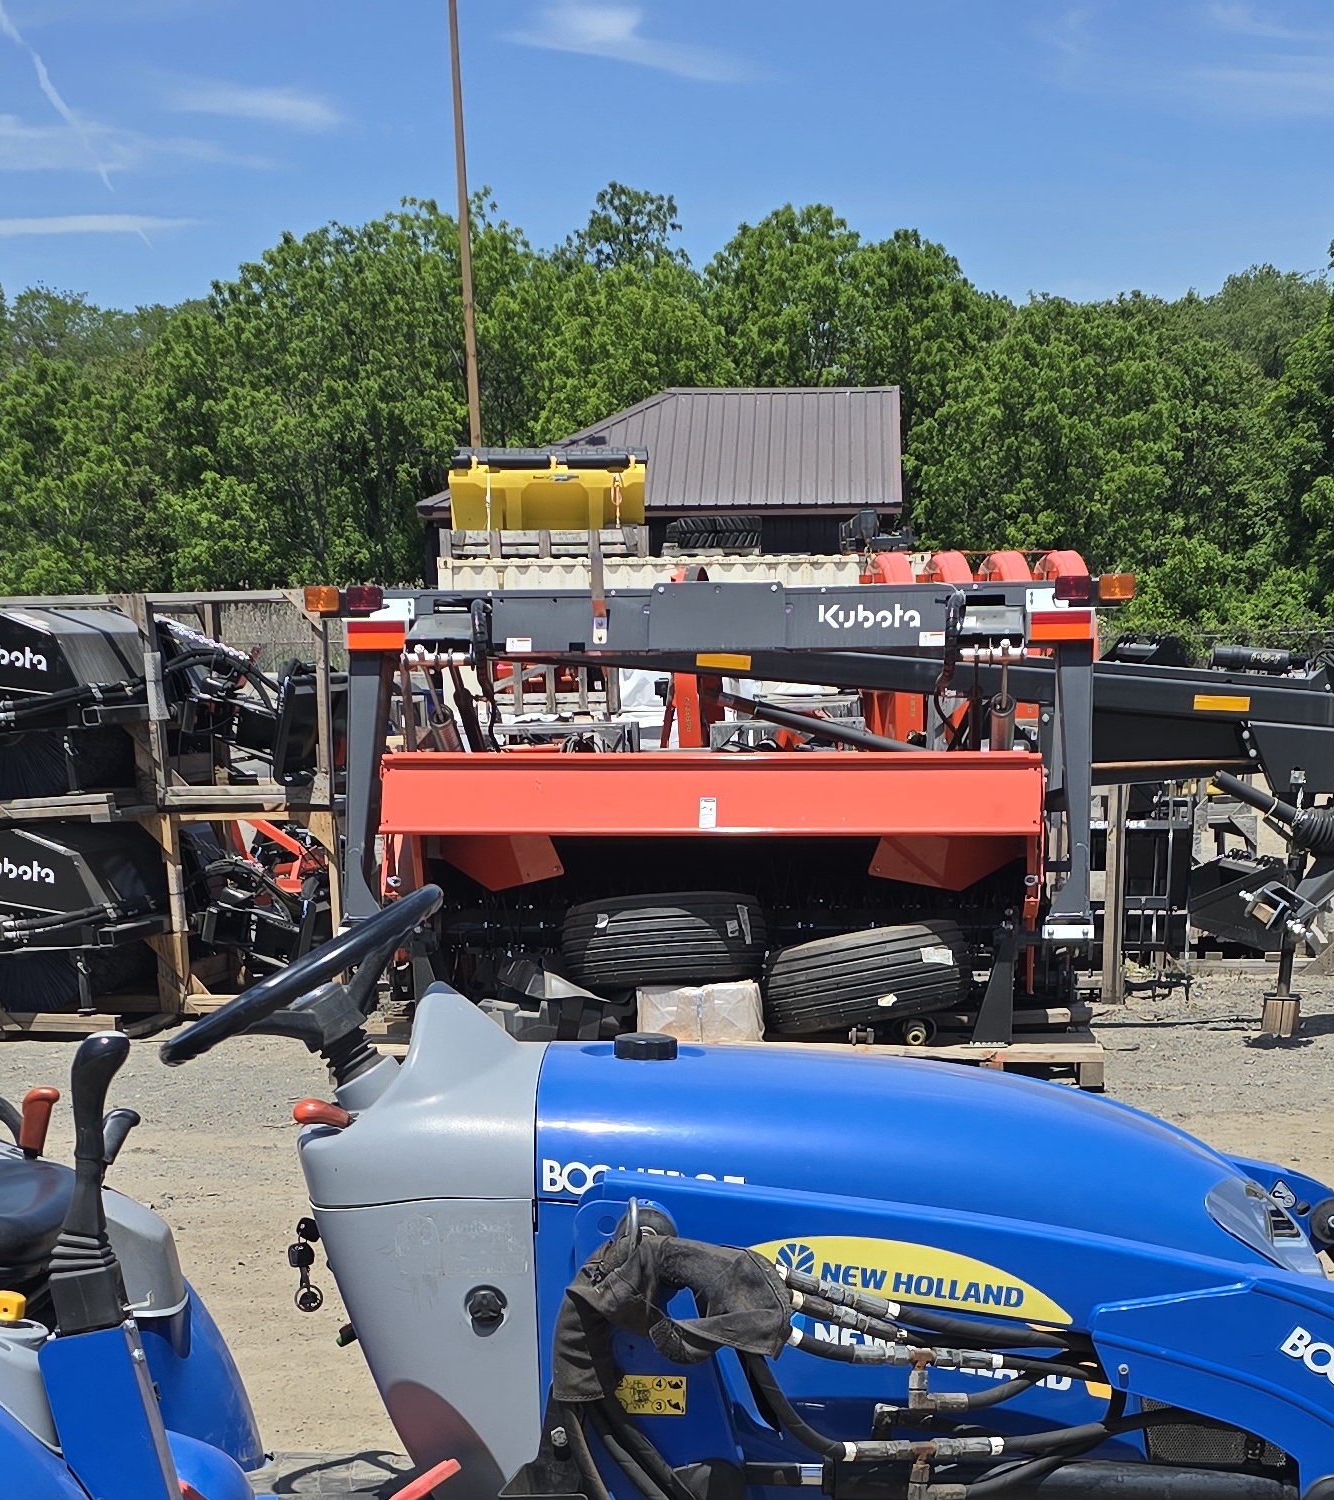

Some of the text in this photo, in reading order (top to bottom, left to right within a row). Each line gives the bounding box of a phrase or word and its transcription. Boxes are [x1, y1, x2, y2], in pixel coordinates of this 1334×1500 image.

[818, 603, 921, 628] Kubota
[820, 1262, 1025, 1308] NEW HOLLAND
[655, 1378, 663, 1389] 4
[655, 1401, 663, 1411] 3
